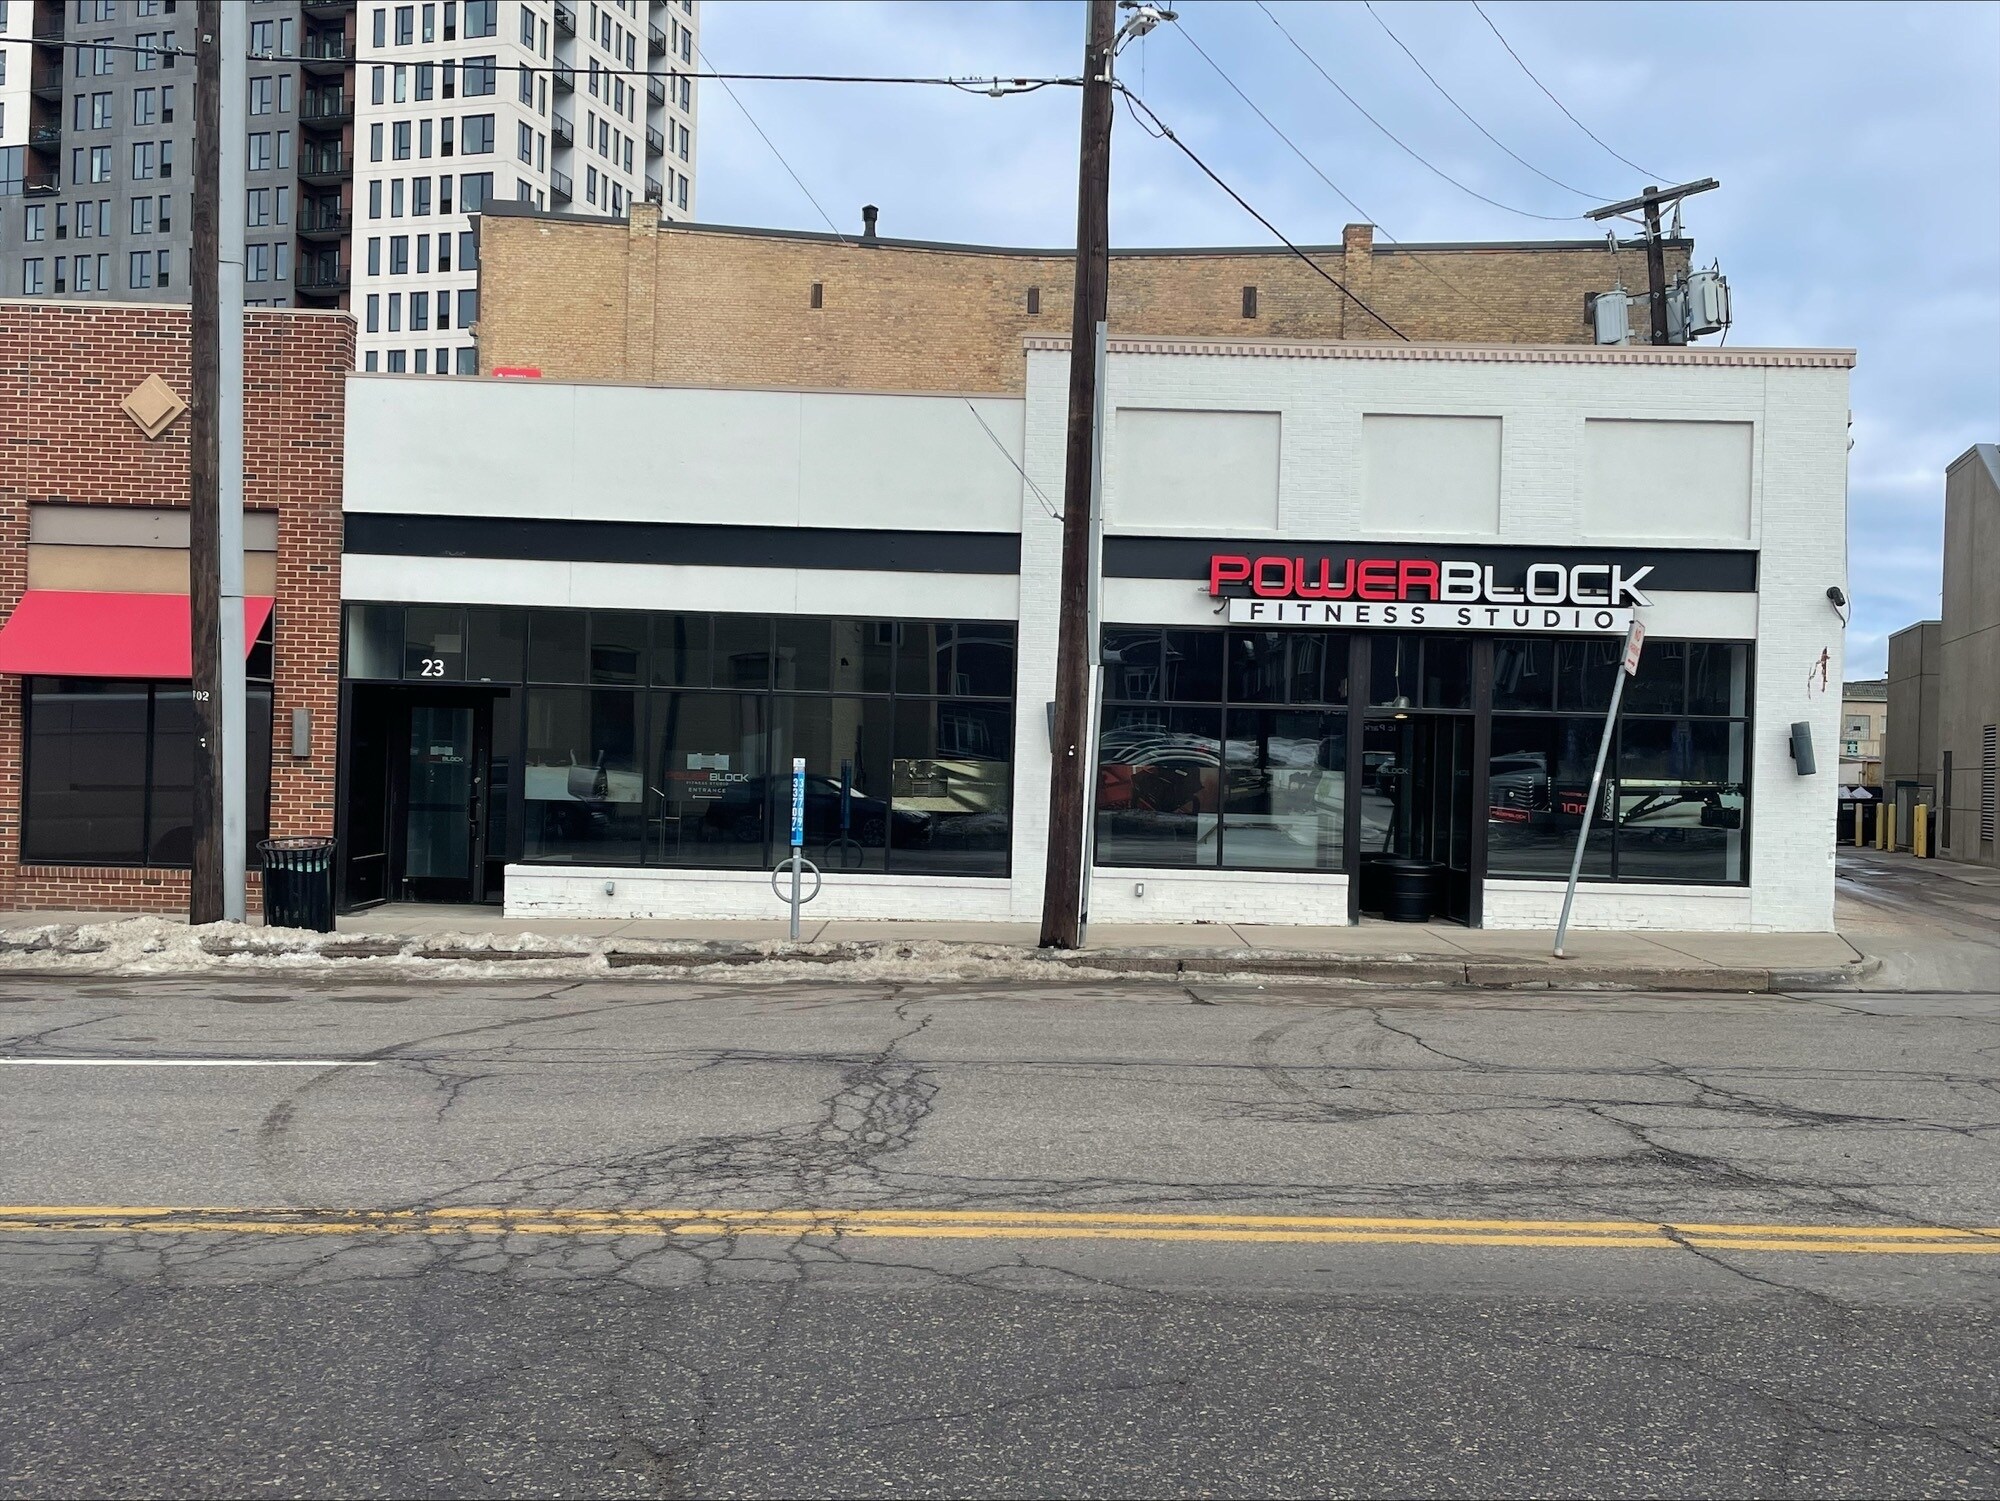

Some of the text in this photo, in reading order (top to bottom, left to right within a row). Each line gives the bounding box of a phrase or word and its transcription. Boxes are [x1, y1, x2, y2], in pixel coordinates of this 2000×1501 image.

[1209, 555, 1654, 607] POWERBLOCK
[1250, 602, 1614, 629] FITNESS STUDIO
[421, 658, 445, 677] 23
